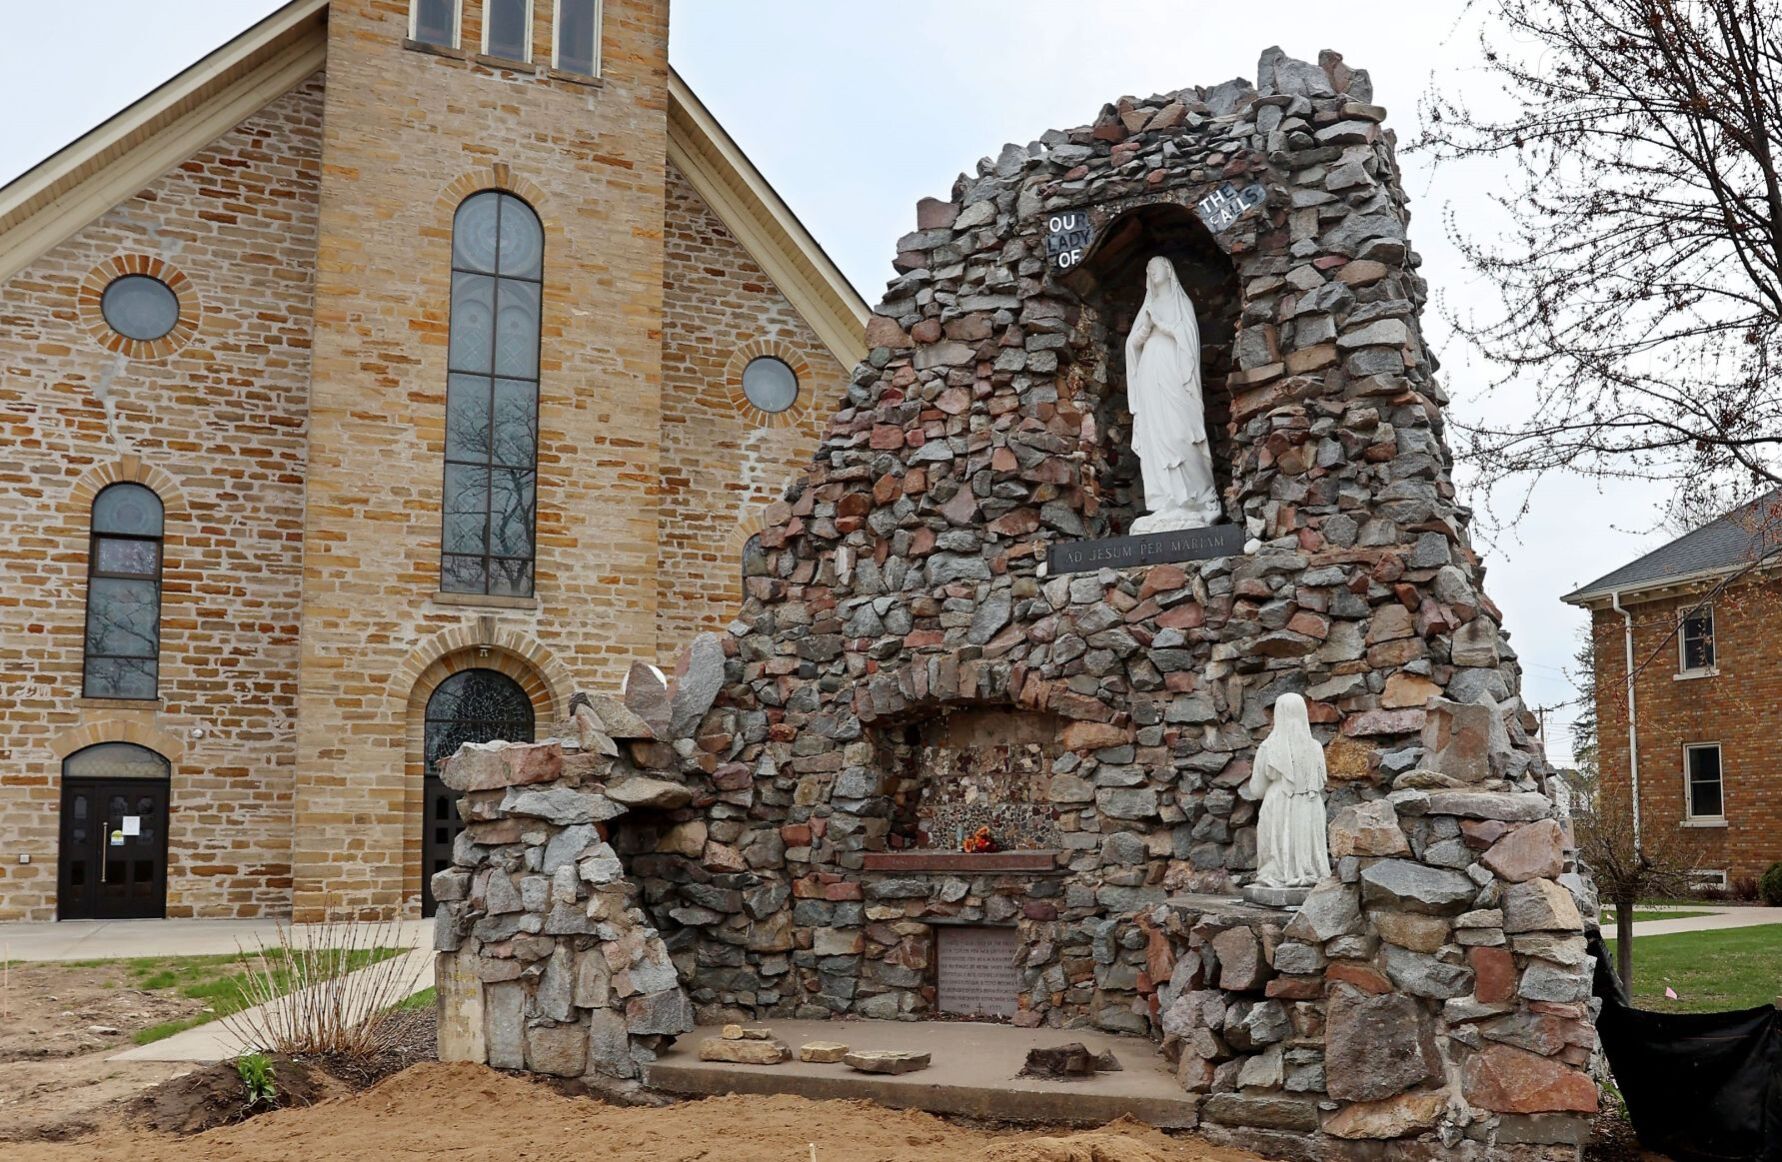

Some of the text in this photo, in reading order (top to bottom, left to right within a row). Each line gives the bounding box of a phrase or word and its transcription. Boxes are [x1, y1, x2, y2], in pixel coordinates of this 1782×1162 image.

[1198, 182, 1234, 213] THE
[1049, 213, 1087, 232] OUR
[1047, 229, 1091, 253] LADY
[1058, 249, 1081, 268] OF
[1065, 535, 1224, 563] AD JESUM PER MARIAM
